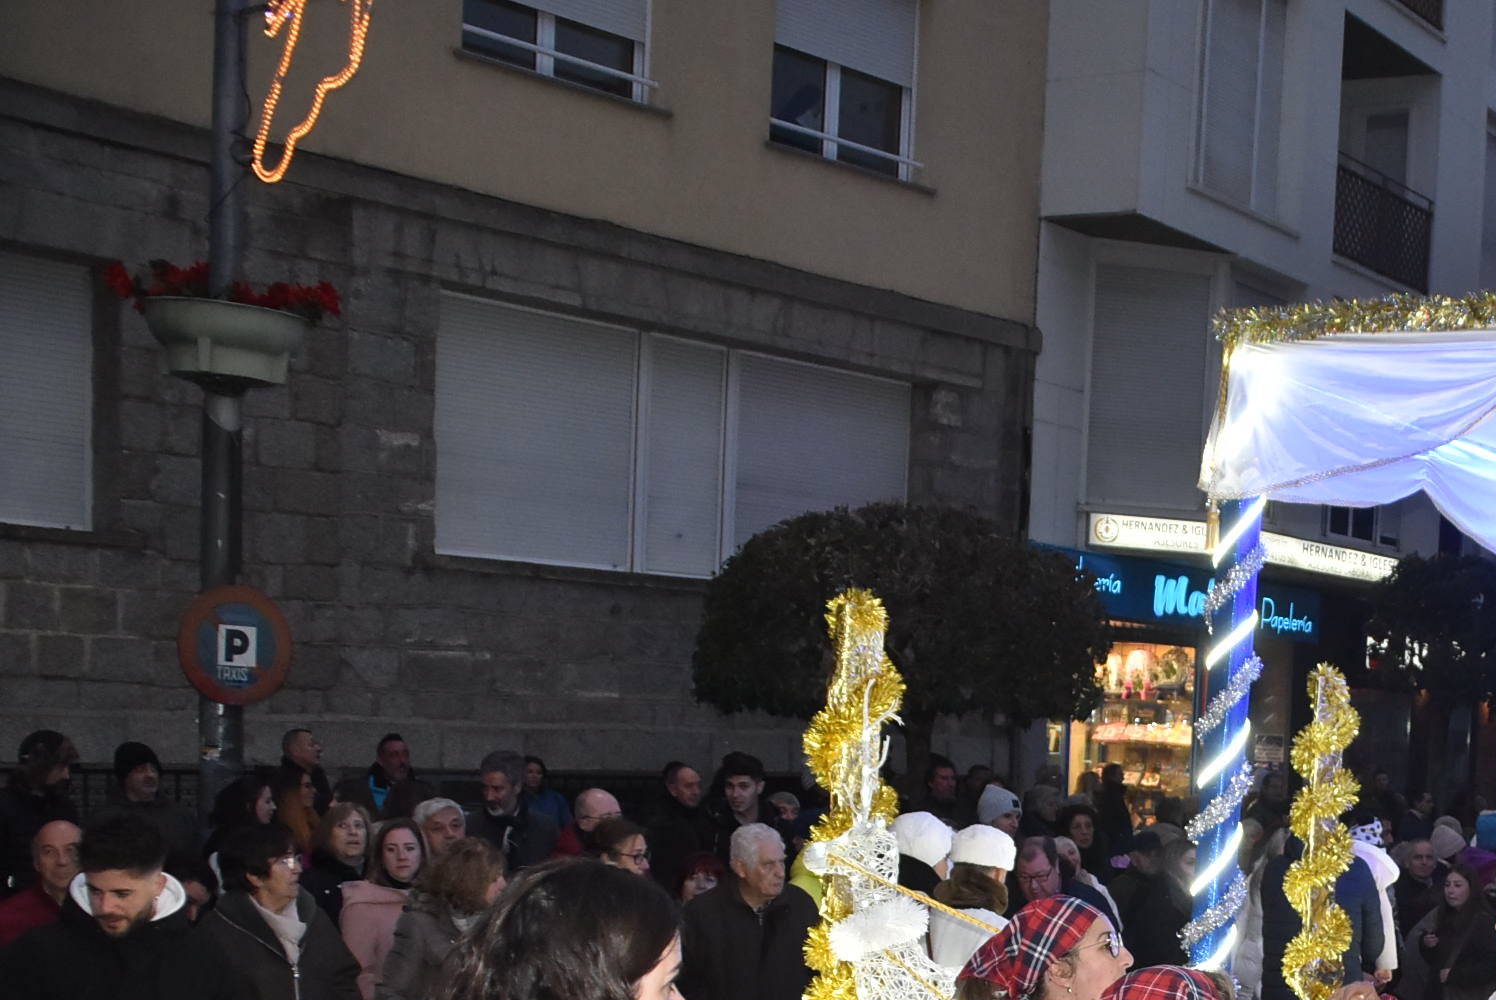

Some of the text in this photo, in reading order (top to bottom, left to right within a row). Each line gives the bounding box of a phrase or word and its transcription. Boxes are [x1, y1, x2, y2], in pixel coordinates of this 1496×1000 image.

[1121, 519, 1207, 537] HERNANDEZ & IGL
[1302, 543, 1359, 565] HERNANDEZ
[1360, 554, 1367, 567] &
[1153, 574, 1215, 617] Ma
[1260, 597, 1313, 635] Papelería
[224, 628, 250, 663] P
[216, 665, 248, 681] TAXIS
